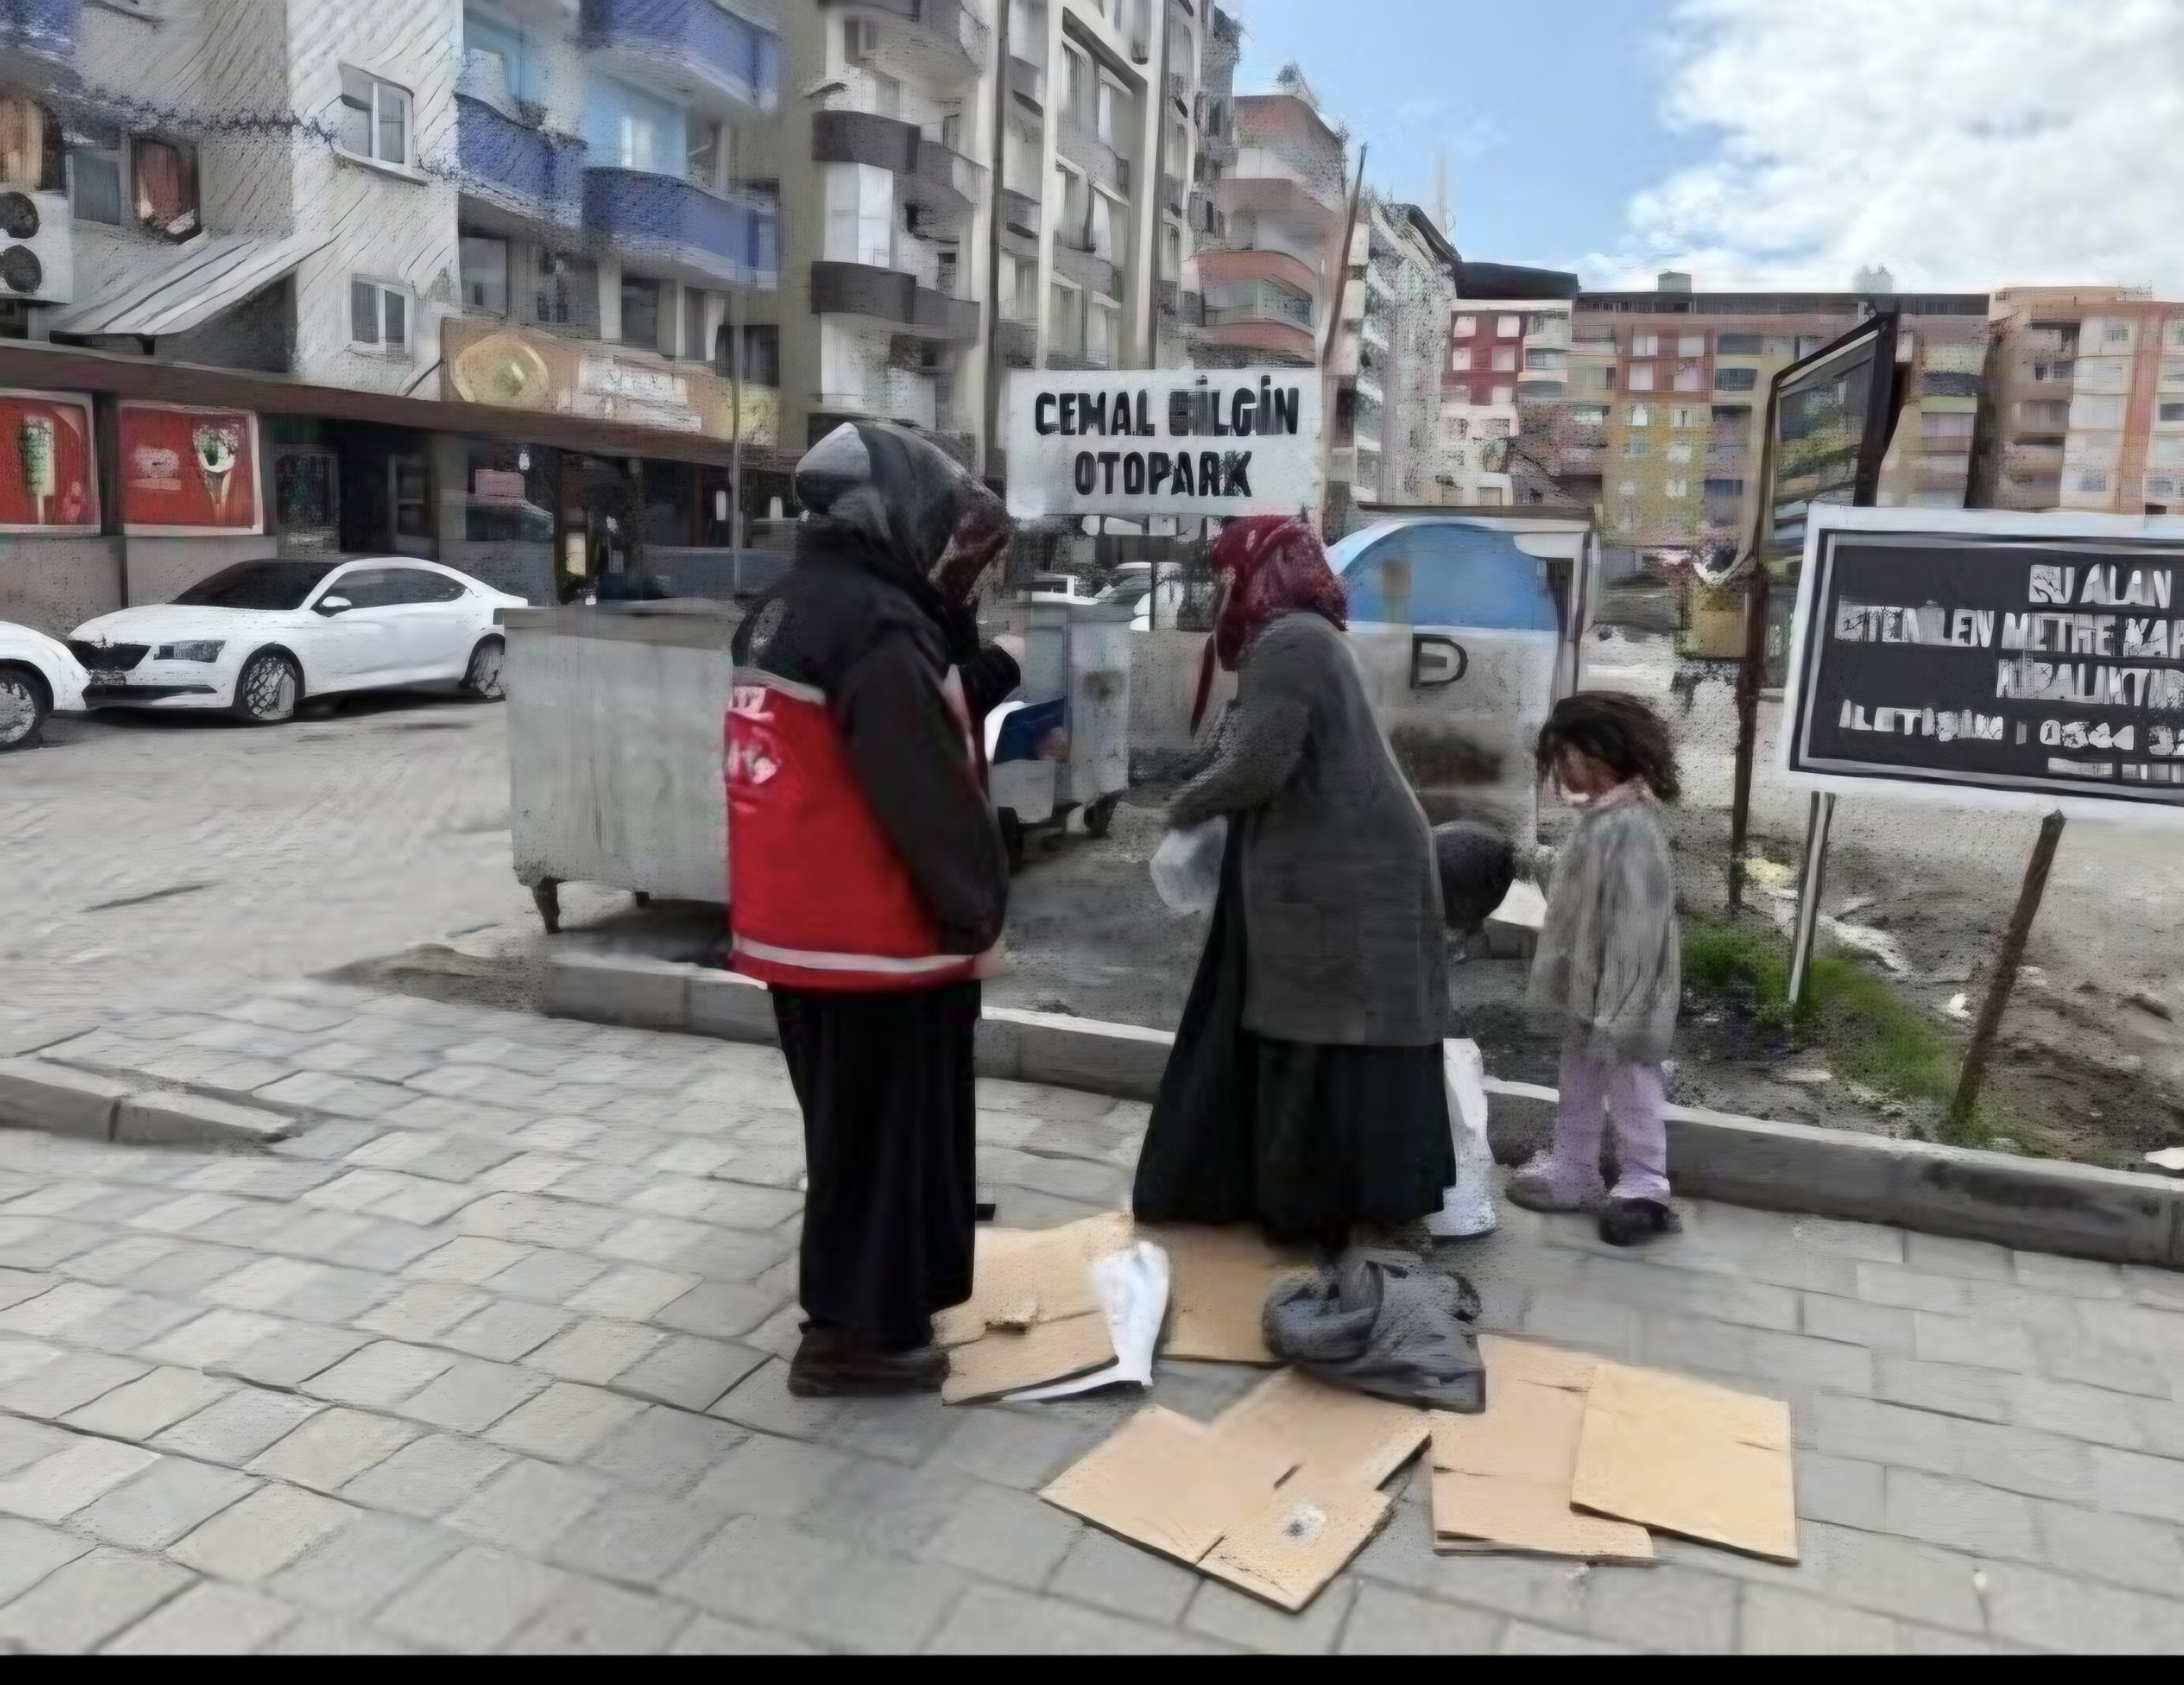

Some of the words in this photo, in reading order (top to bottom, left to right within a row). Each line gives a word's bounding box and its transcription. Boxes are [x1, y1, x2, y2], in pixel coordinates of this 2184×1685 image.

[1035, 389, 1155, 436] CEMAL
[1169, 375, 1299, 436] BİLGİN
[1075, 450, 1252, 497] OTOPARK
[2080, 563, 2172, 609] ALAN
